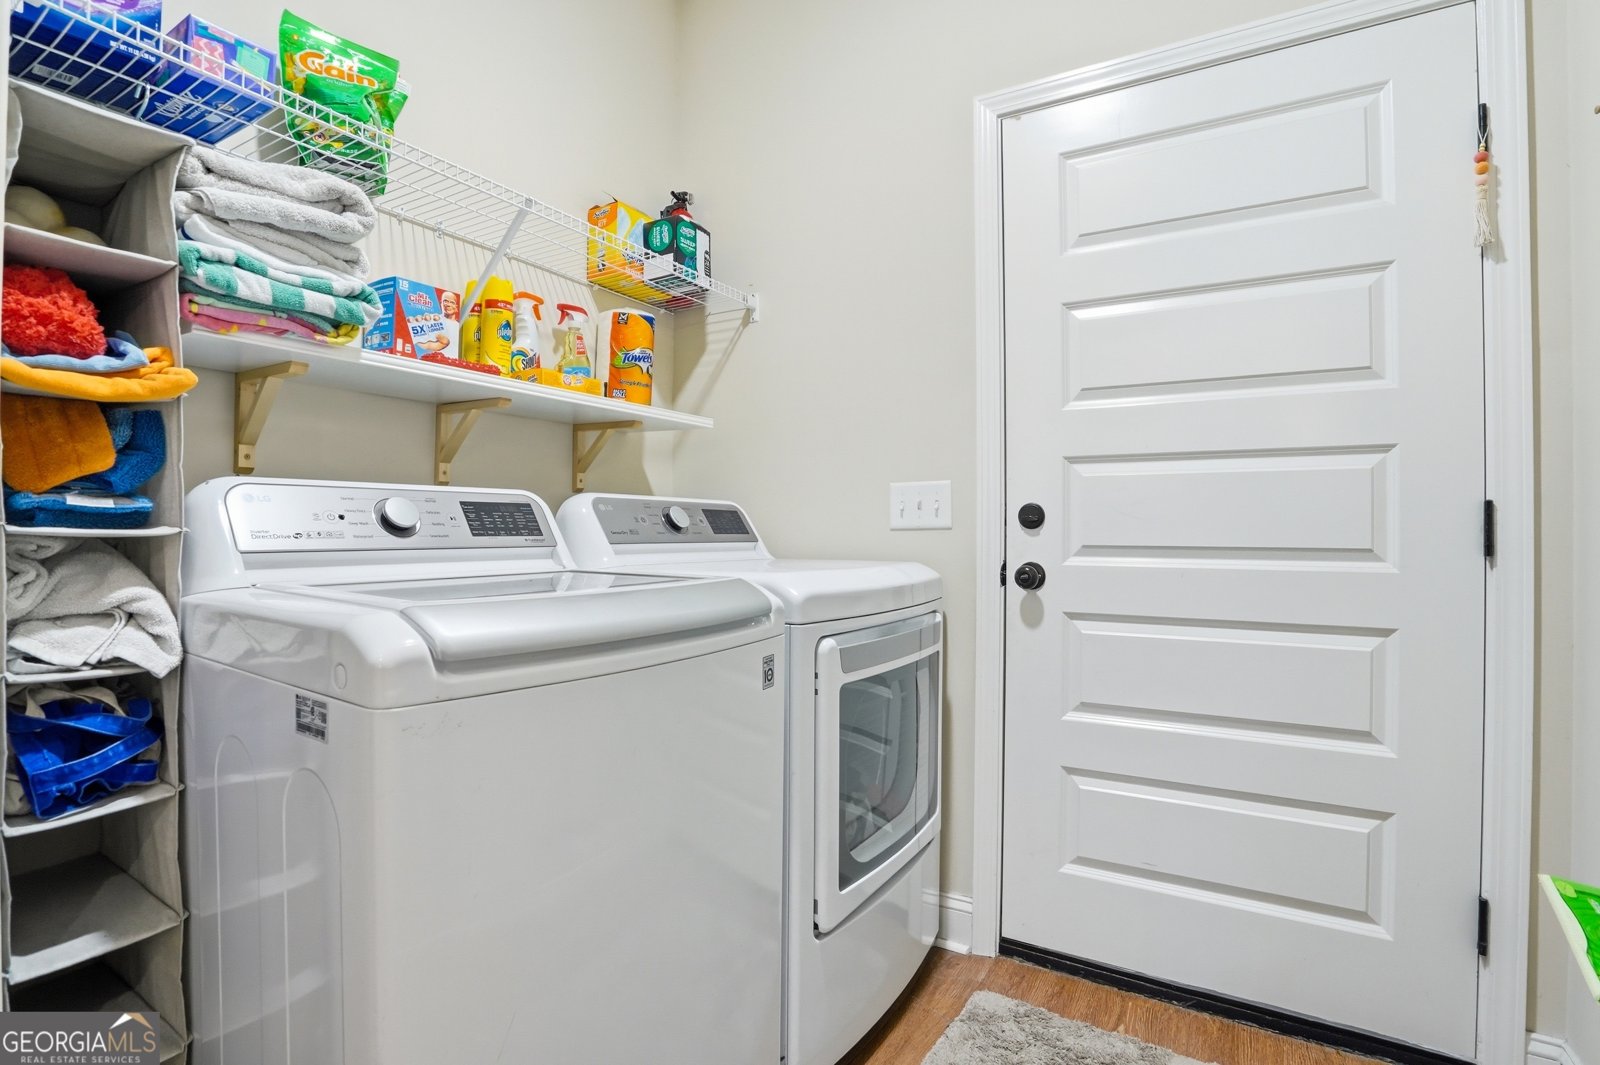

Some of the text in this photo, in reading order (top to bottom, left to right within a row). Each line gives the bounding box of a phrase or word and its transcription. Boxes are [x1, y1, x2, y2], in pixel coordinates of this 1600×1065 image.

[297, 49, 378, 89] Gain
[408, 294, 433, 307] Clean
[411, 324, 426, 335] 5X
[621, 351, 653, 364] Towels
